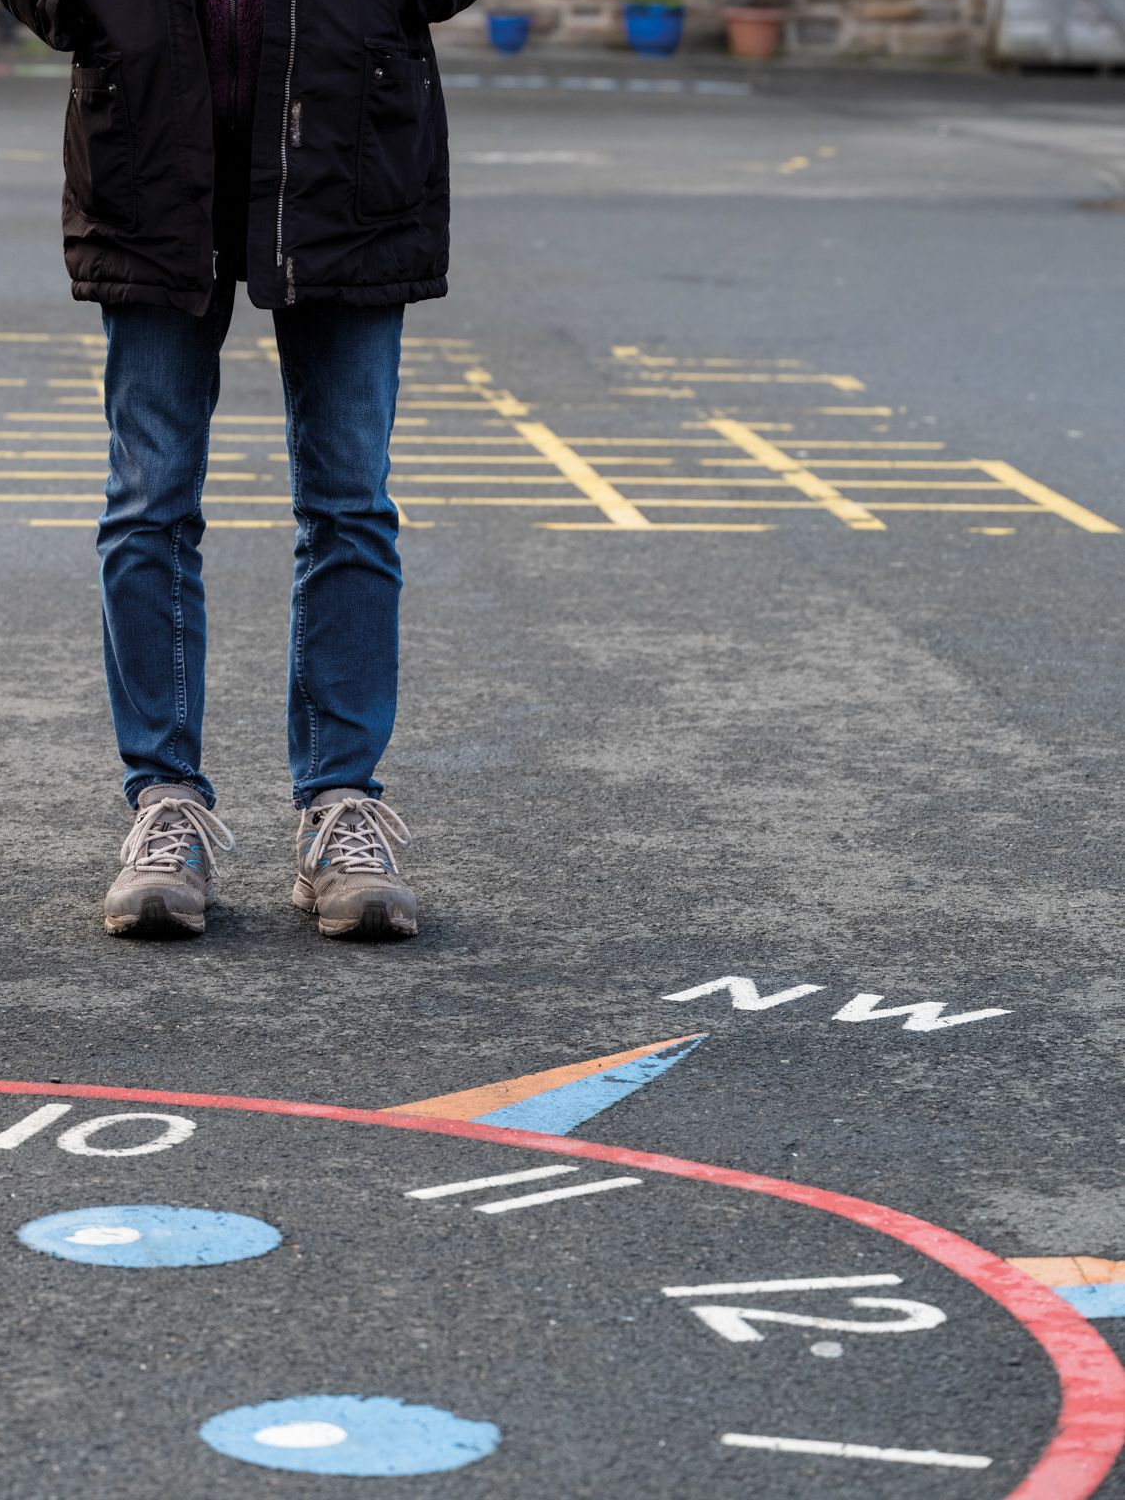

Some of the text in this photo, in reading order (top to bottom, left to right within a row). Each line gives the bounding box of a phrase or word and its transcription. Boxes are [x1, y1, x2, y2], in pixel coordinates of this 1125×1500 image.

[662, 975, 1013, 1033] NW
[404, 1164, 644, 1214] 11
[660, 1273, 947, 1342] 12
